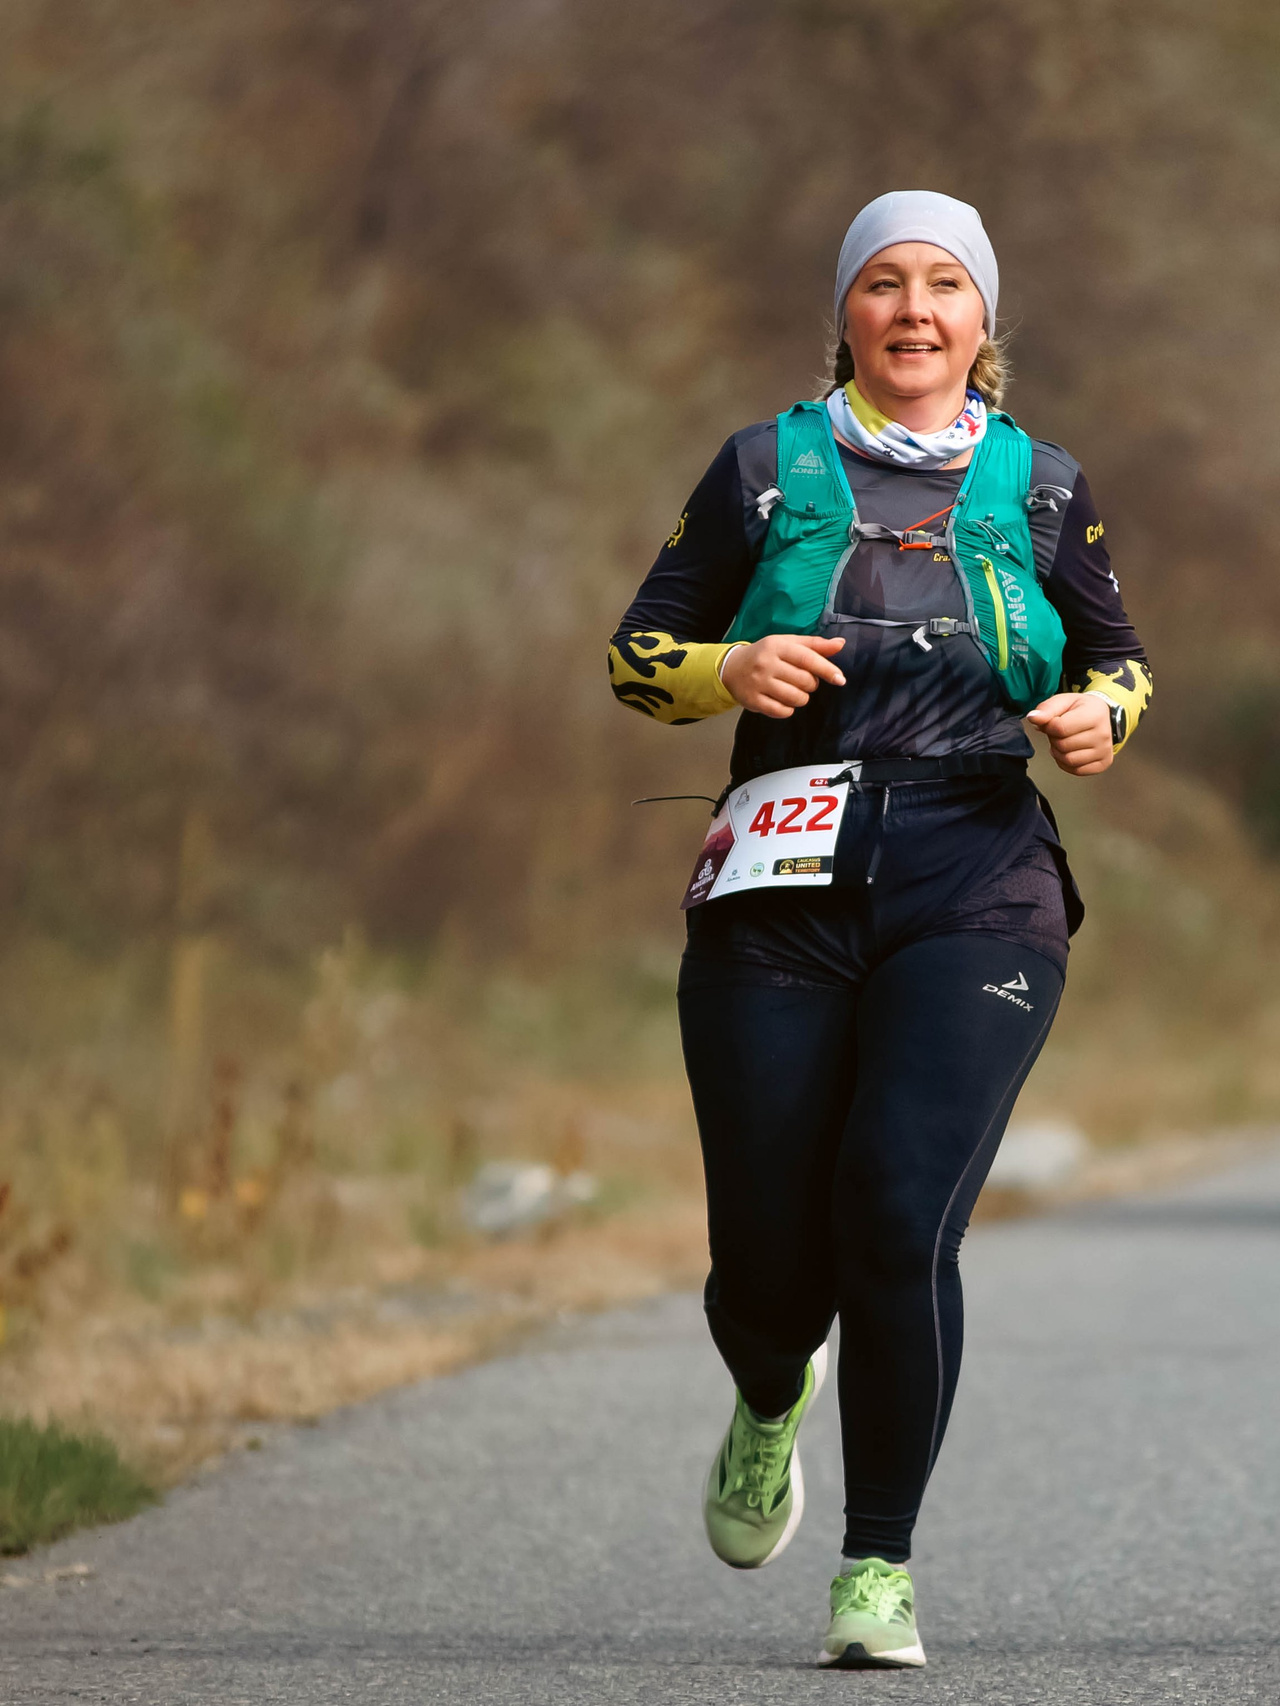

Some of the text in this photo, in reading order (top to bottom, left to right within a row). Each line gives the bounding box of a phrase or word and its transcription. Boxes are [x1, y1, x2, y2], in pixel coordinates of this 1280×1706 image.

[933, 552, 951, 562] Cra
[748, 795, 839, 838] 422
[982, 983, 1035, 1012] DEMIX
